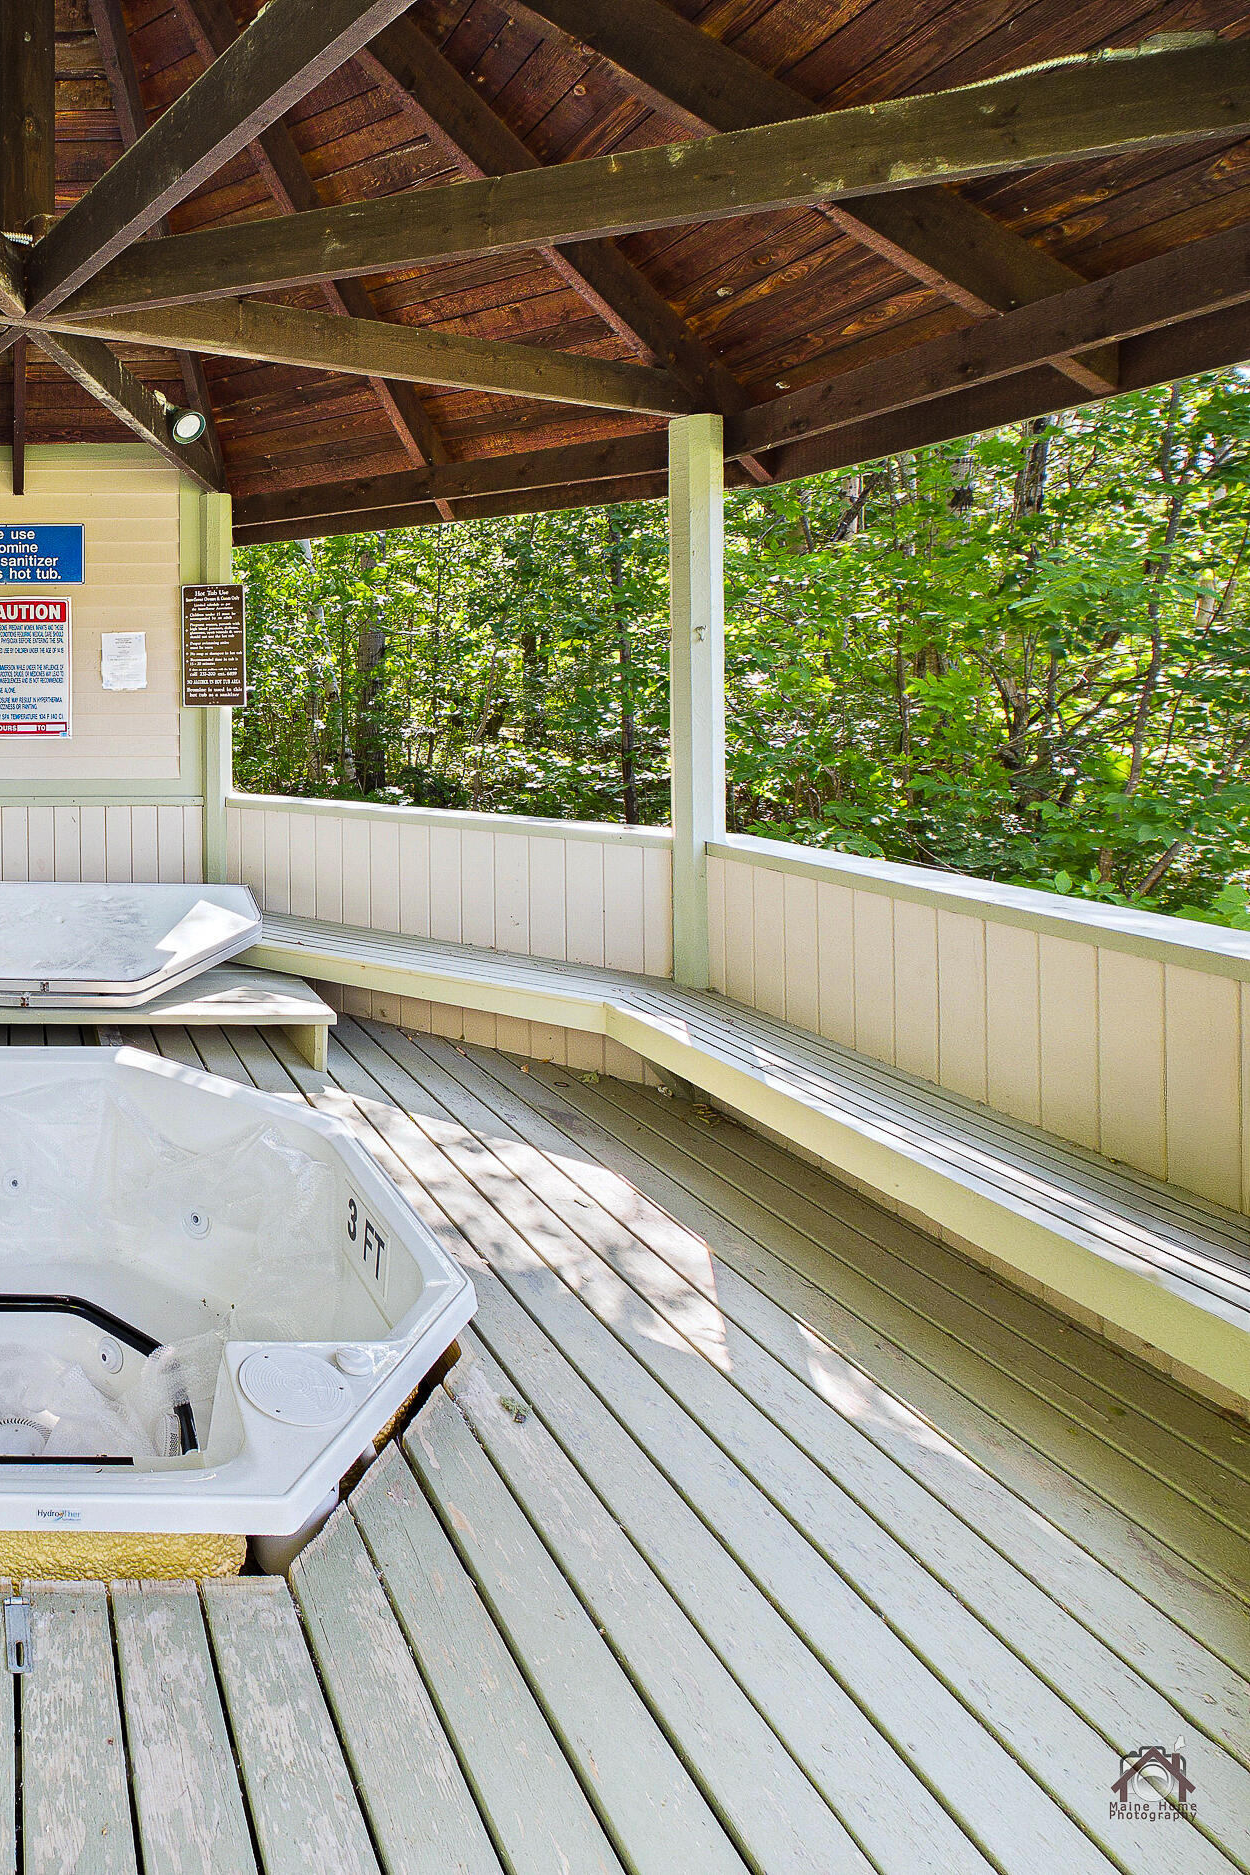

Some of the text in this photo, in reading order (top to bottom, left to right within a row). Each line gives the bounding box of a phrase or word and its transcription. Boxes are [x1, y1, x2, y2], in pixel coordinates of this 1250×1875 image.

[11, 530, 35, 539] use
[1, 555, 58, 566] sanitizer
[10, 568, 35, 579] hot
[36, 568, 61, 579] tub.
[348, 1198, 385, 1280] 3 FT
